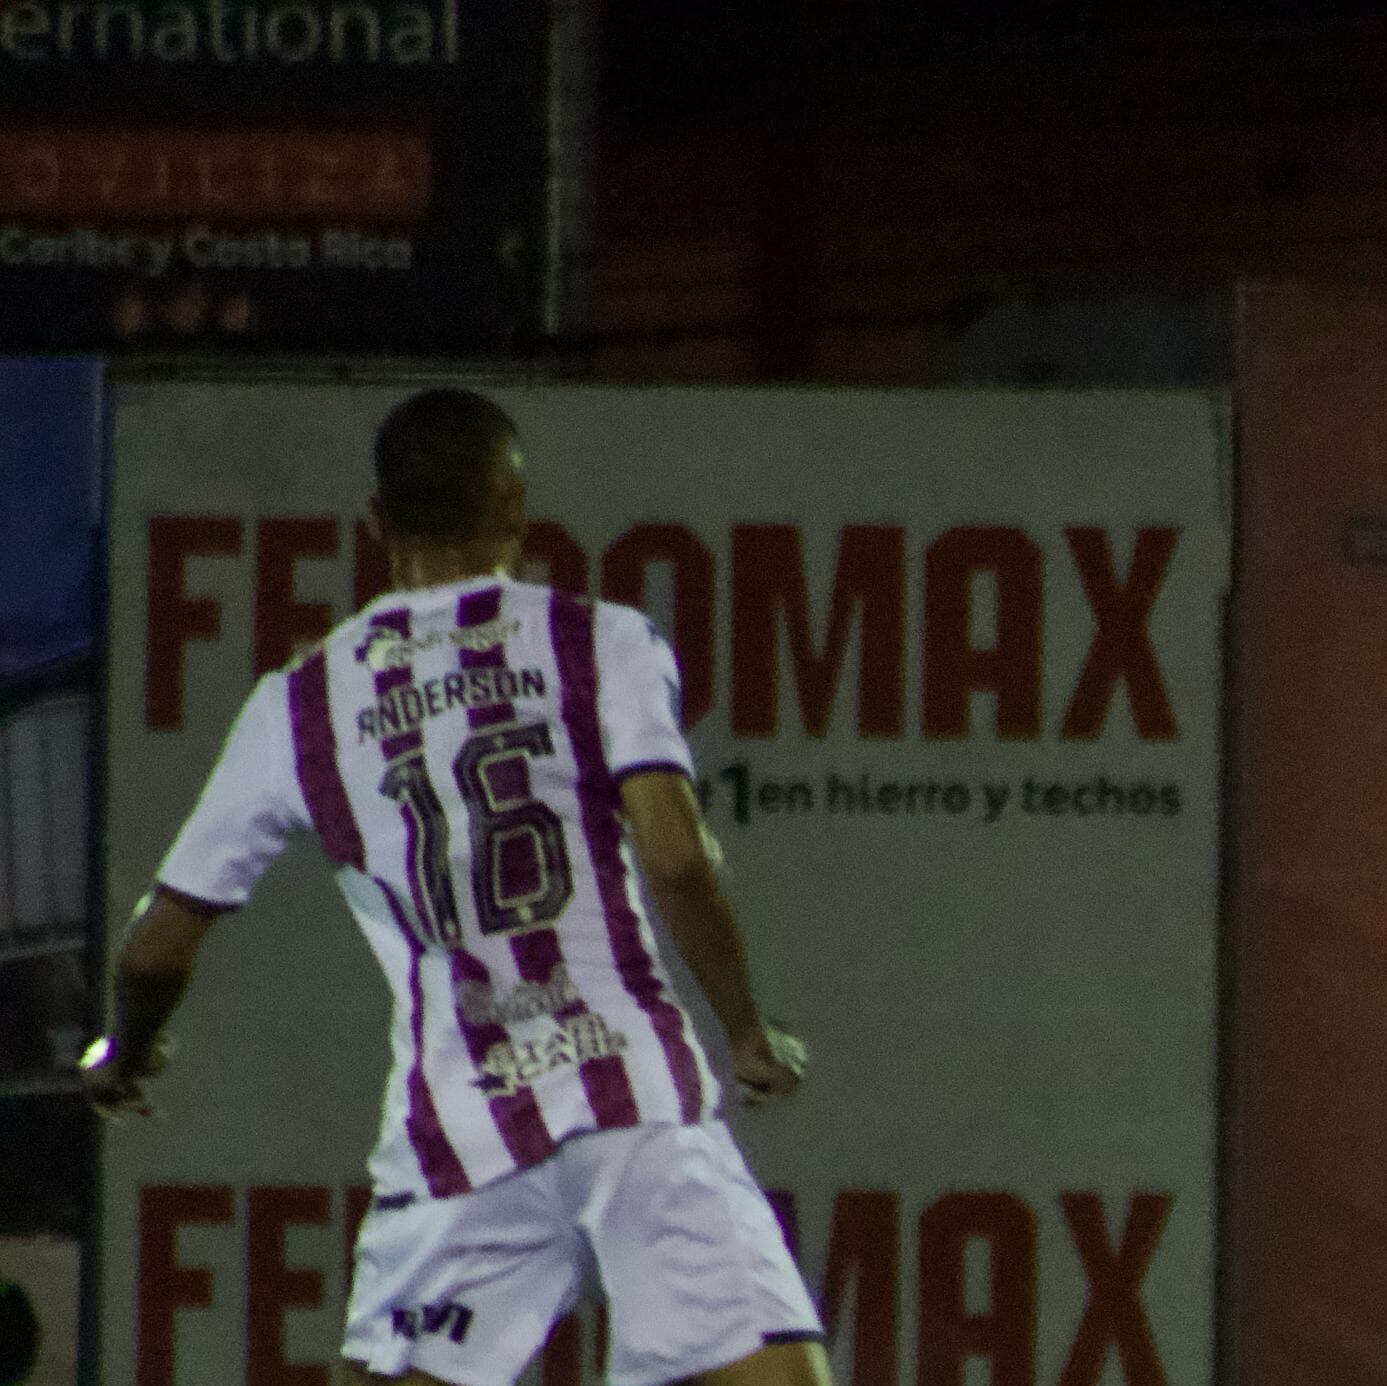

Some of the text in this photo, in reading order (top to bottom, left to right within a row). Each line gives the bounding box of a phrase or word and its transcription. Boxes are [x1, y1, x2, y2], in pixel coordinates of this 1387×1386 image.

[356, 666, 547, 746] ANDERSON
[758, 781, 814, 813] en
[825, 765, 968, 818] hierro
[982, 779, 1010, 823] y
[1022, 770, 1182, 818] techos
